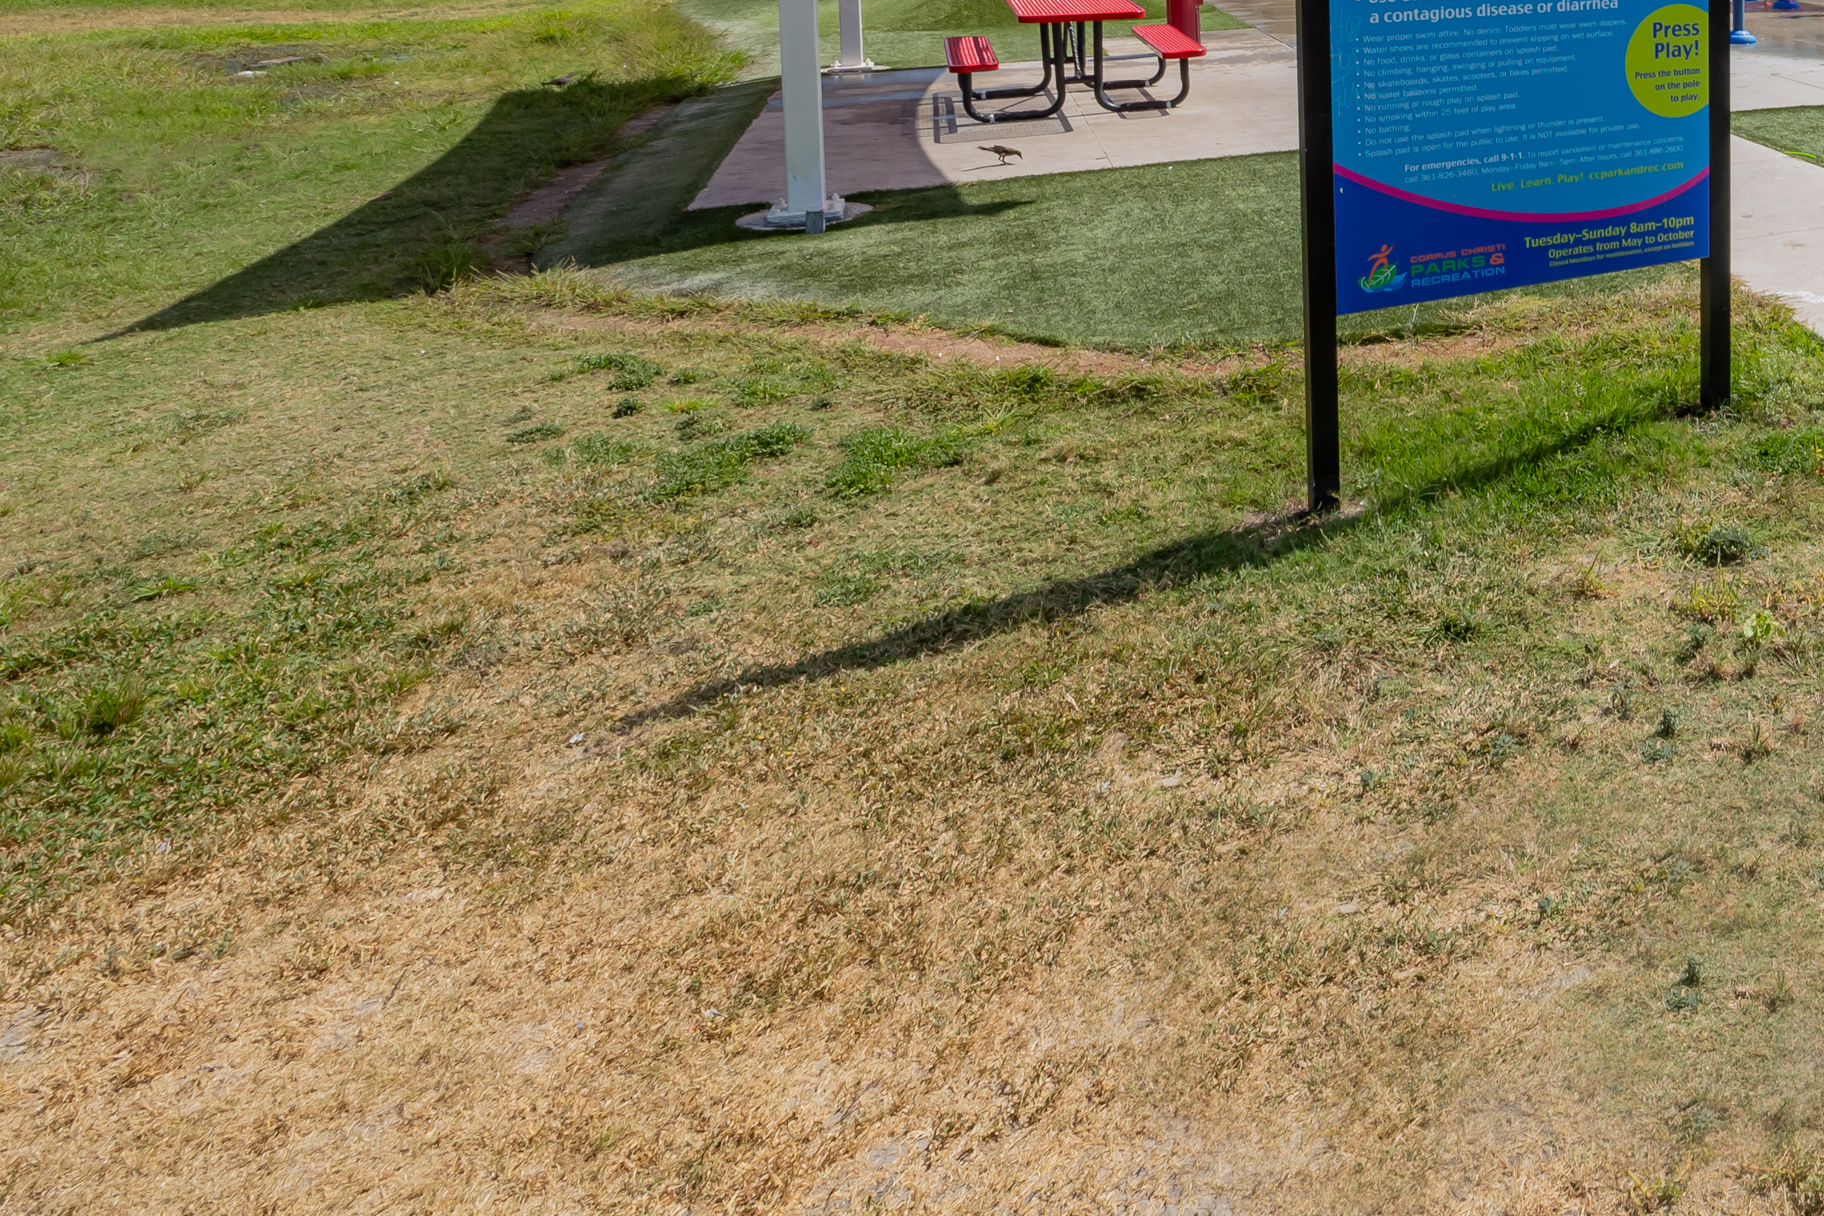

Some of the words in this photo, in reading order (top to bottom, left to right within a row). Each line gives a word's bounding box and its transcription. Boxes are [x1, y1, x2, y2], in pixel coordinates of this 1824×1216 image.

[1369, 12, 1379, 23] a
[1383, 5, 1472, 23] contagious
[1476, 2, 1533, 17] disease
[1536, 1, 1552, 13] or
[1652, 22, 1699, 38] Press
[1654, 40, 1698, 62] Play!
[1634, 71, 1656, 79] Press
[1657, 69, 1671, 77] the
[1673, 68, 1700, 76] button
[1667, 81, 1680, 89] the
[1682, 79, 1700, 90] pole
[1377, 101, 1409, 110] running
[1421, 97, 1444, 106] rough
[1446, 96, 1462, 105] play
[1476, 92, 1501, 102] splash
[1680, 92, 1701, 102] play.
[1378, 112, 1413, 121] smoking
[1414, 109, 1438, 118] within
[1470, 105, 1478, 113] of
[1480, 104, 1496, 113] play
[1404, 164, 1419, 172] For
[1484, 154, 1499, 163] call
[1537, 148, 1559, 158] report
[1557, 172, 1583, 184] Play!
[1410, 250, 1456, 262] CORPUS
[1461, 243, 1506, 255] CHRISTI
[1548, 245, 1593, 260] Operates
[1596, 241, 1619, 252] from
[1621, 237, 1642, 248] May
[1644, 235, 1655, 245] to
[1656, 229, 1694, 243] October
[1410, 255, 1486, 276] PARKS
[1489, 253, 1505, 265] &
[1411, 265, 1505, 287] RECREATION
